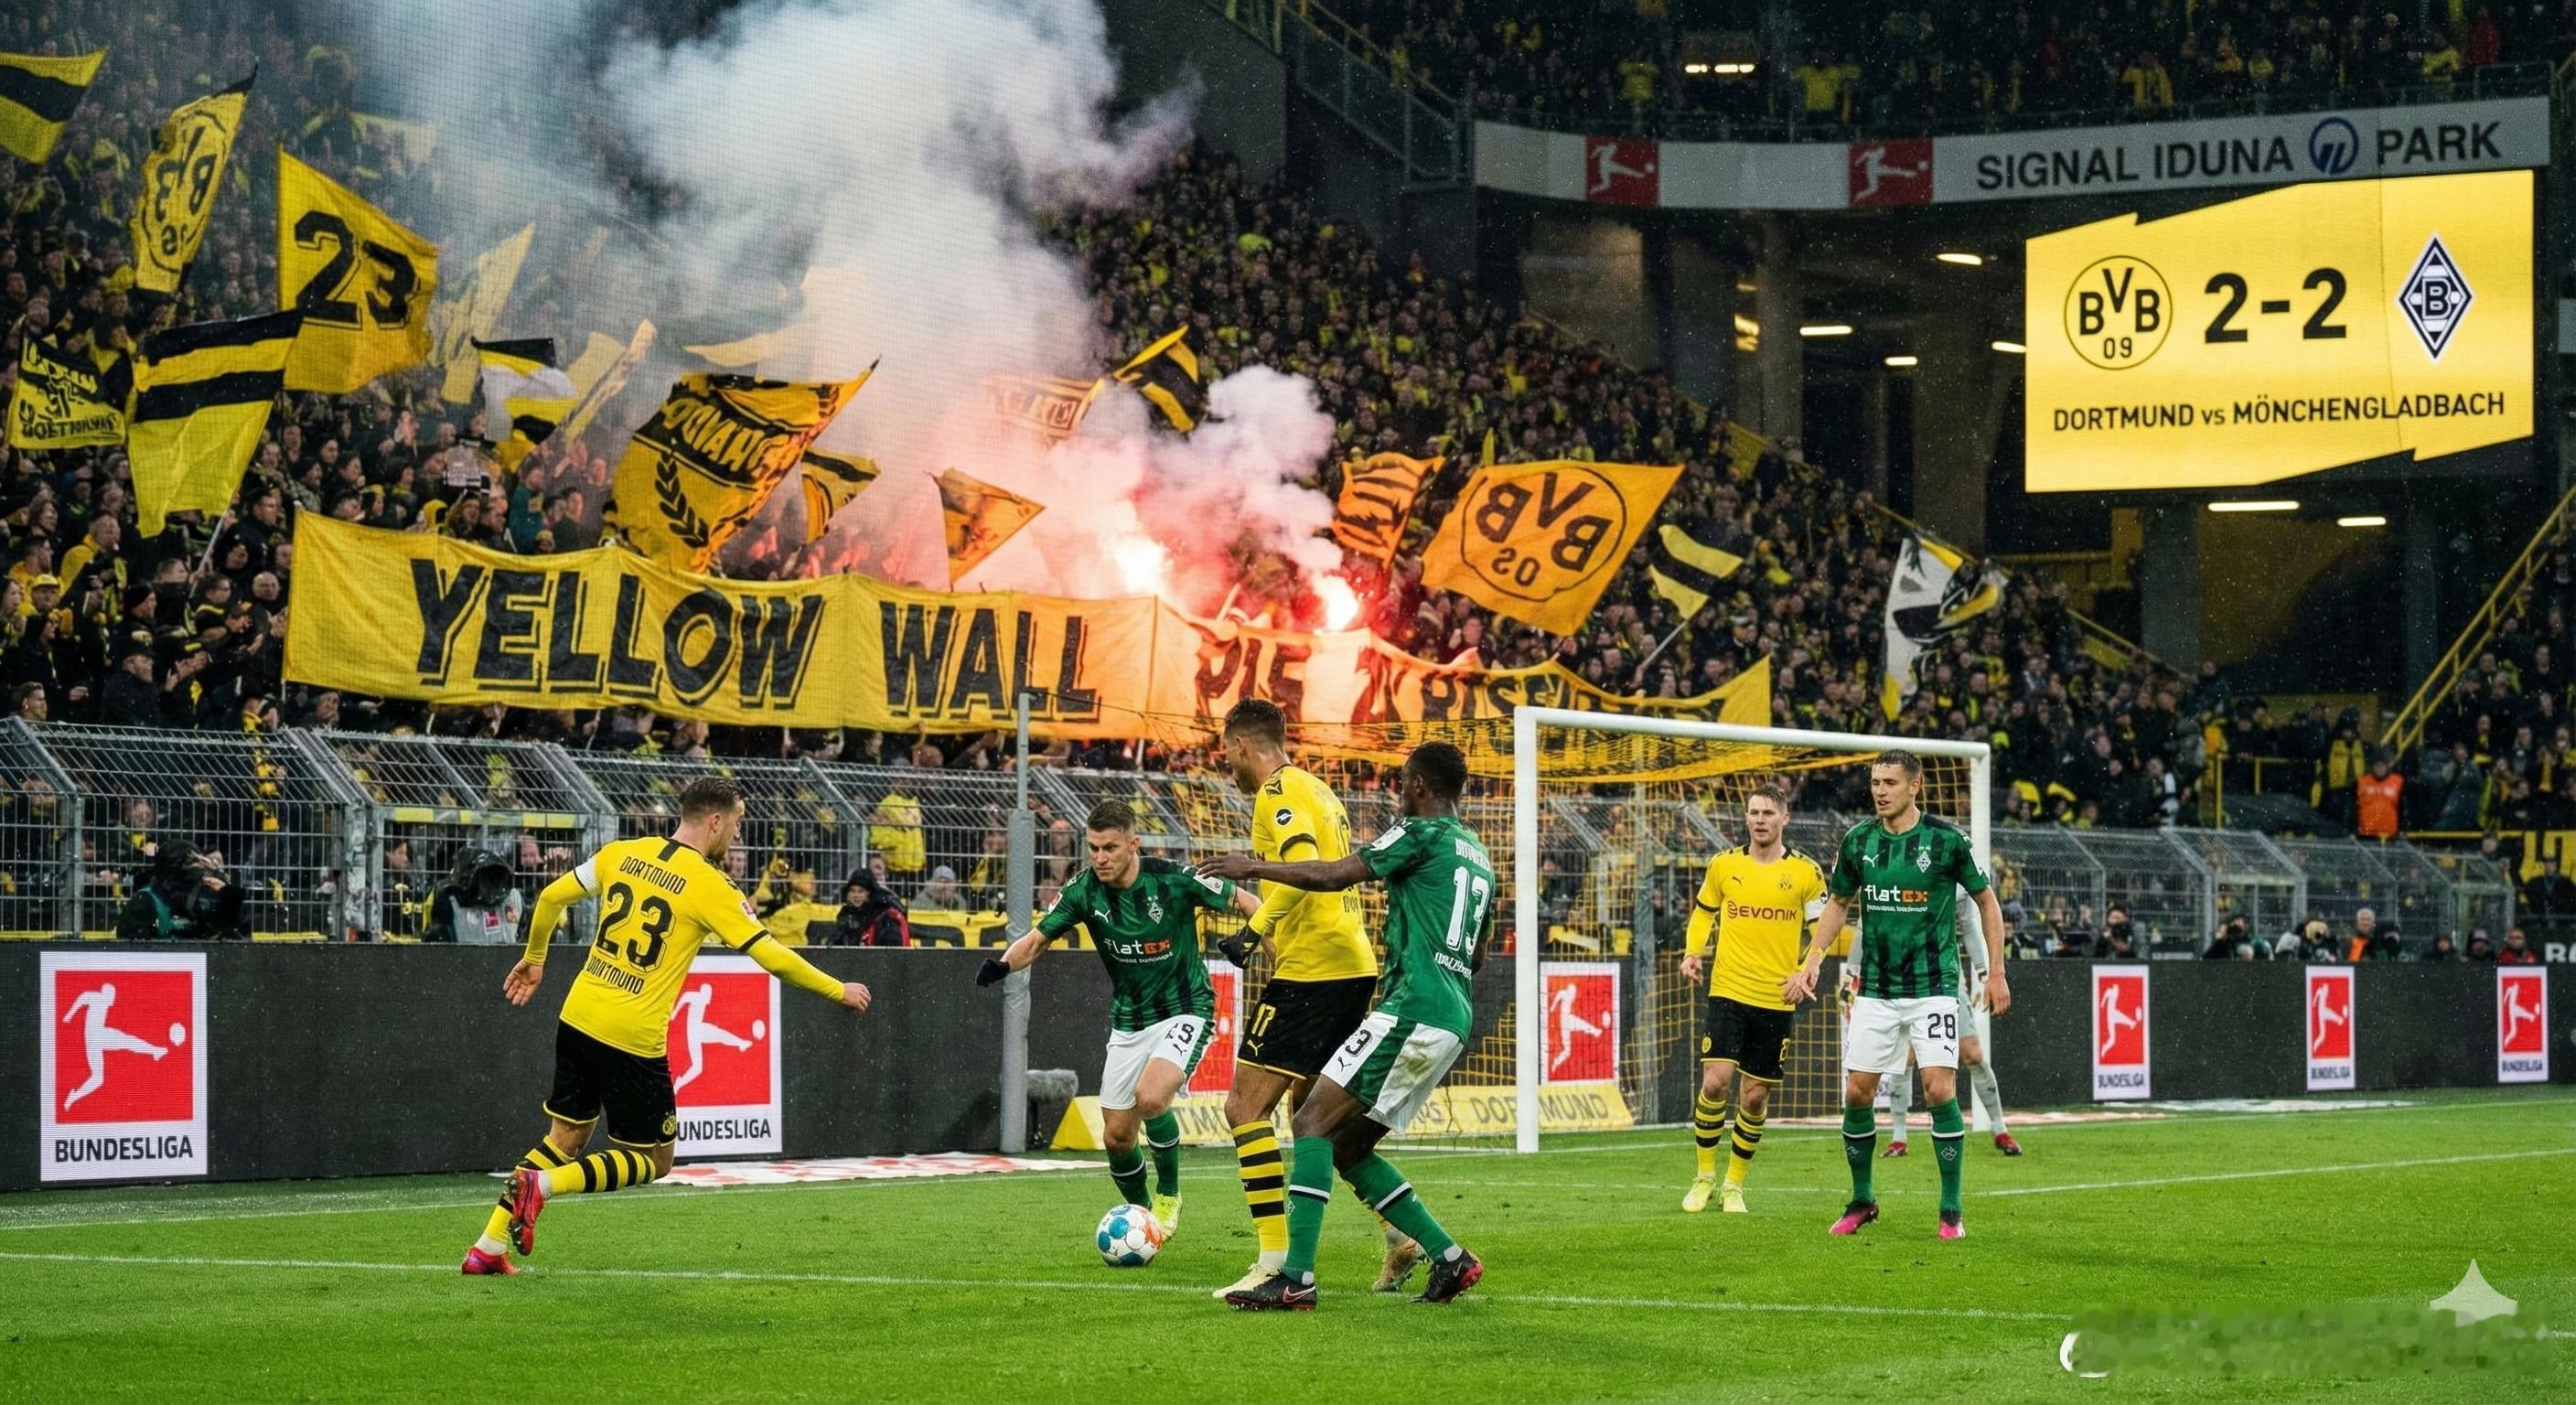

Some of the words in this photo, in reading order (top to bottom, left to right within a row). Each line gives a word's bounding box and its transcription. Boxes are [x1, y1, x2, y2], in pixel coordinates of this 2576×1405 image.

[1976, 146, 2139, 191] SIGNAL
[2154, 135, 2294, 180] IDUNA
[2379, 121, 2502, 166] PARK
[295, 209, 421, 330] 23
[2079, 267, 2160, 336] BVB
[2205, 268, 2346, 343] 2-2
[2104, 337, 2132, 359] 09
[2055, 403, 2195, 432] DORTMUND
[2233, 391, 2505, 424] MÖNCHENGLADBACH
[410, 558, 823, 710] YELLOW
[879, 600, 1101, 724] WALL
[619, 856, 686, 896] DORTMUND
[596, 881, 676, 973] 23
[1446, 865, 1490, 956] 13
[1251, 1003, 1276, 1036] 17
[1927, 1013, 1957, 1040] 28
[55, 1135, 194, 1163] BUNDESLIGA
[677, 1119, 772, 1142] UNDESLIGA
